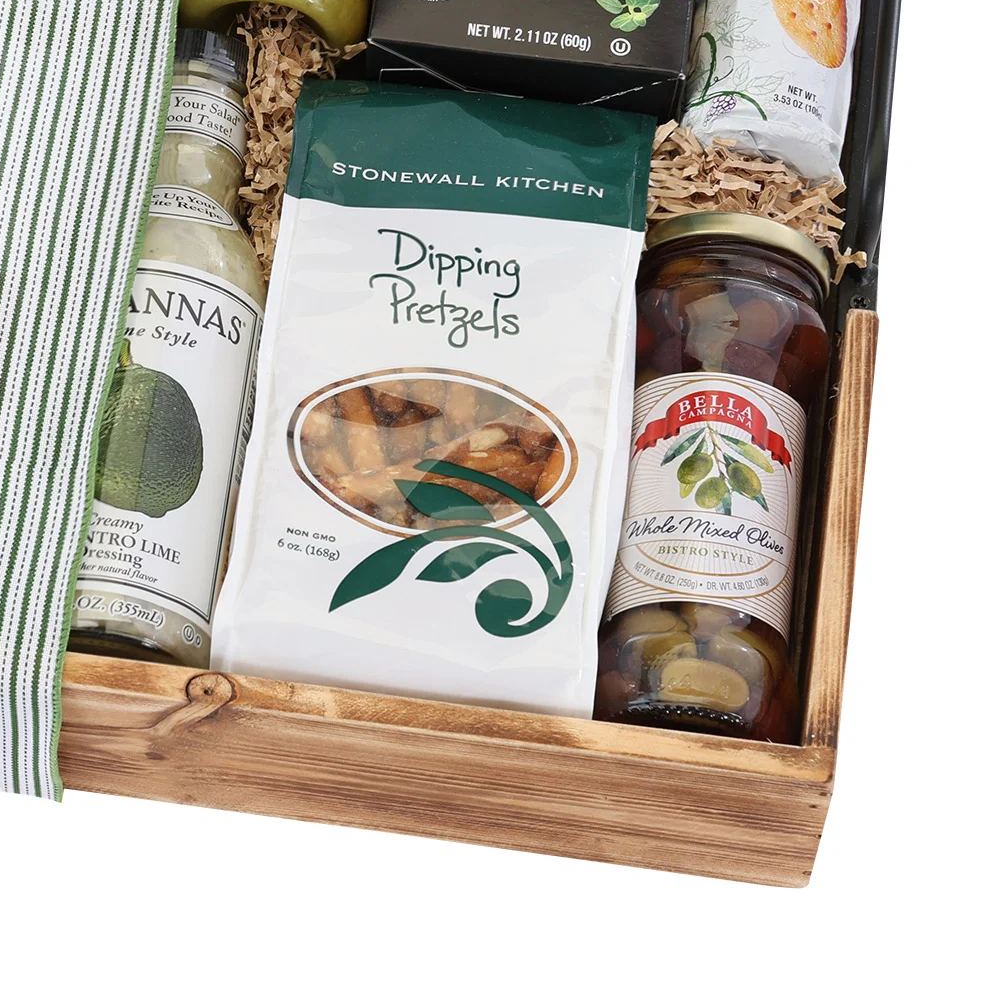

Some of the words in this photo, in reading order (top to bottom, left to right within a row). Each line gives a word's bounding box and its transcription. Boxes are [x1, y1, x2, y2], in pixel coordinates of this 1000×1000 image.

[467, 23, 490, 38] NET
[492, 25, 511, 41] WT.
[514, 28, 540, 43] 2.11
[542, 30, 558, 46] OZ
[560, 32, 592, 51] (60g)
[788, 85, 803, 97] NET
[804, 90, 817, 103] WT.
[174, 96, 207, 111] Your
[210, 103, 239, 127] Salad
[331, 161, 485, 187] STONEWALL
[496, 174, 605, 199] KITCHEN
[176, 201, 224, 221] Recipe
[377, 228, 521, 299] Dipping
[369, 274, 520, 349] Pretzels
[151, 325, 198, 349] Style
[678, 394, 753, 420] BELLA
[678, 407, 752, 429] CAMPAGNA
[90, 512, 144, 534] Creamy
[286, 527, 309, 537] NON
[312, 532, 336, 543] GMO
[626, 516, 678, 540] Whole
[678, 516, 744, 540] Mixed
[746, 527, 784, 555] Olives
[277, 538, 284, 547] 6
[287, 543, 302, 552] oz.
[305, 544, 340, 561] (168g)
[657, 545, 709, 557] BISTRO
[713, 550, 754, 565] STYLE
[98, 565, 131, 577] natural
[131, 569, 159, 584] flavor
[77, 596, 106, 611] OZ.
[109, 601, 165, 628] (355mL)
